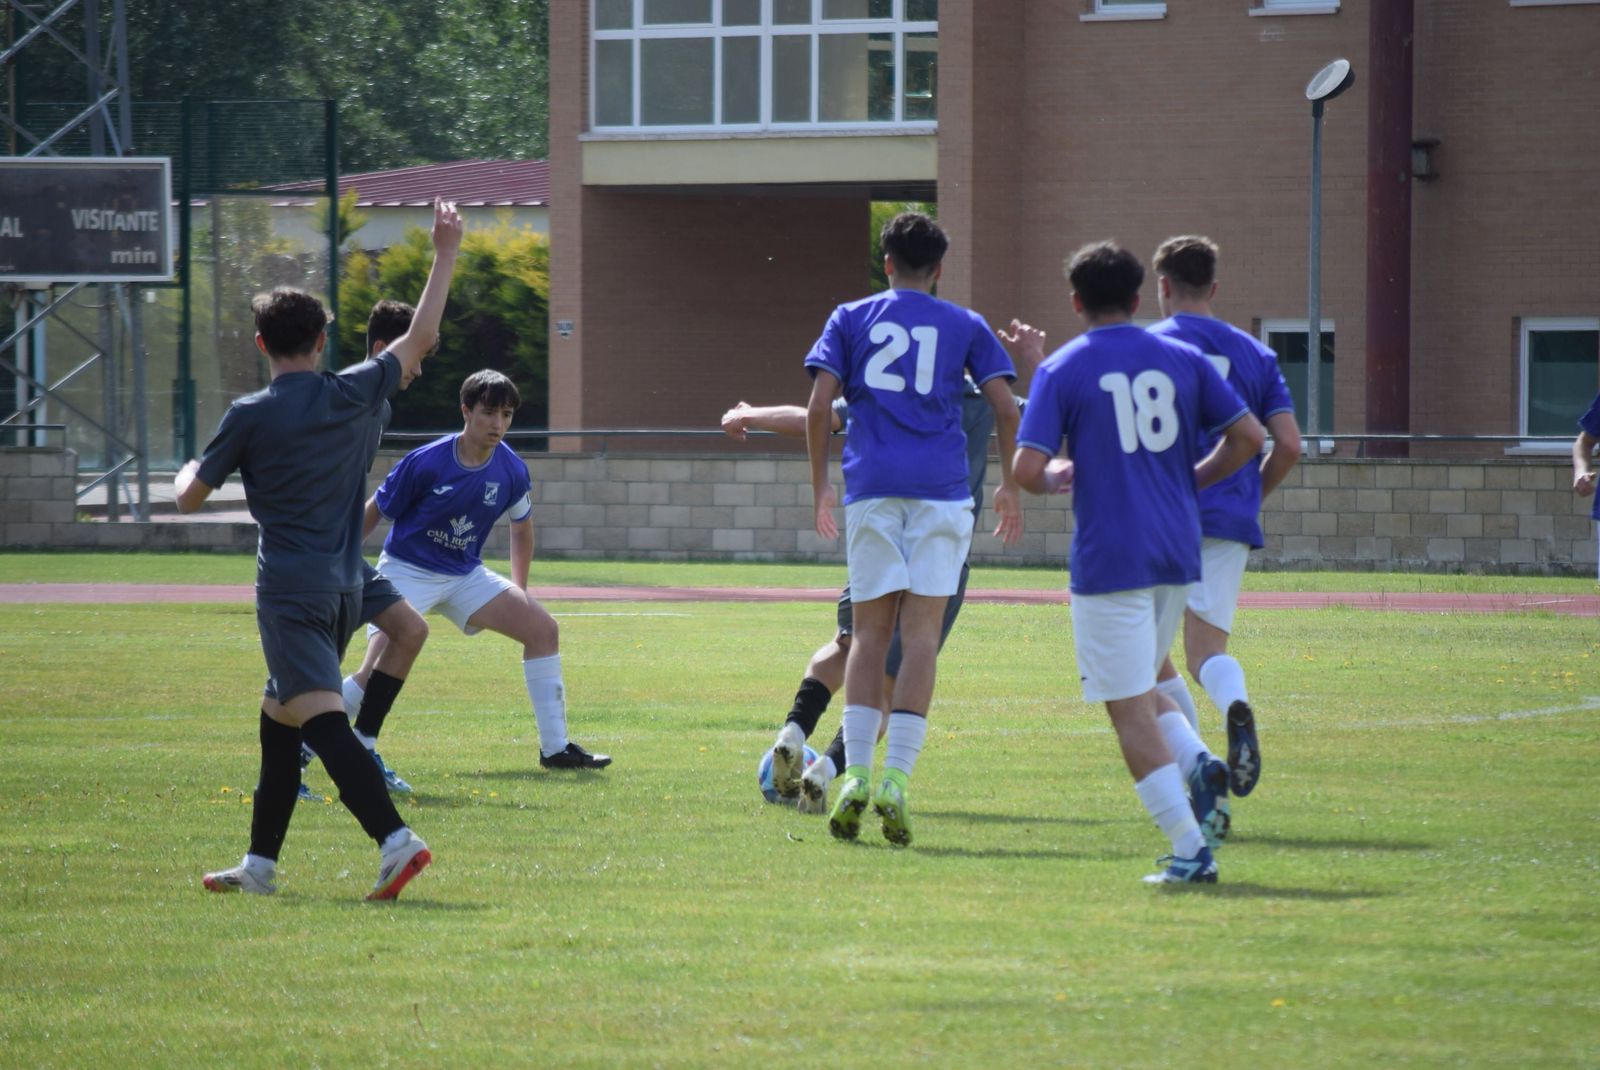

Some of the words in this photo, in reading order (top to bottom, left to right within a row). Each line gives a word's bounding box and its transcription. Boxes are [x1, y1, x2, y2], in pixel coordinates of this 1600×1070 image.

[71, 208, 159, 231] VISITANTE
[110, 246, 157, 264] min
[864, 321, 938, 395] 21
[1099, 369, 1179, 454] 18
